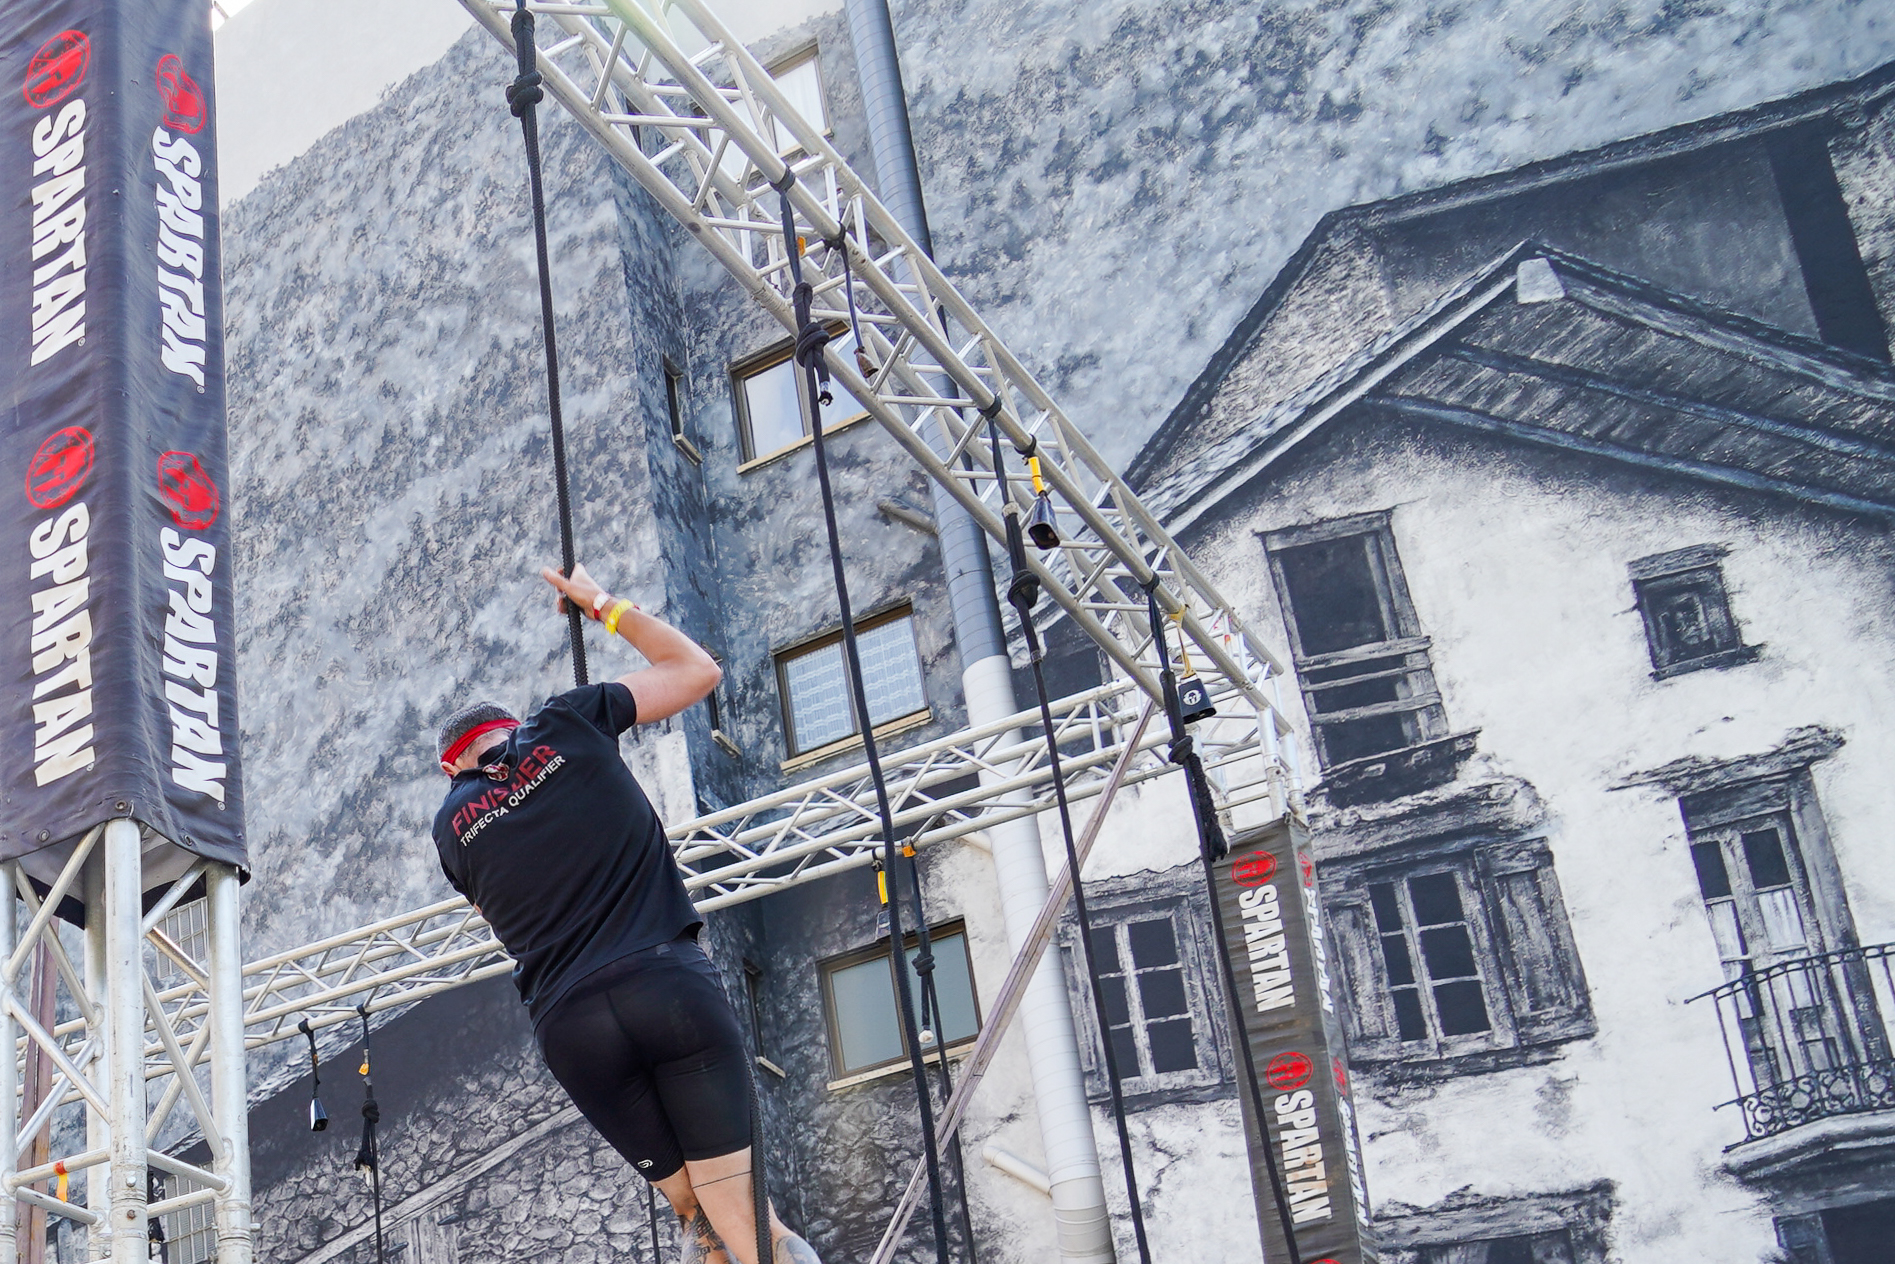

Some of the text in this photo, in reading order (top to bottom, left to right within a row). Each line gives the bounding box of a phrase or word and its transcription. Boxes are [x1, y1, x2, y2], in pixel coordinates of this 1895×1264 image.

[30, 99, 87, 367] SPARTAN
[151, 125, 207, 388] SPARTAN
[29, 501, 96, 788] SPARTAN
[159, 527, 227, 802] SPARTAN
[460, 754, 566, 847] TRIFECTA QUALIFIER
[1238, 884, 1296, 1013] SPARTAN
[1274, 1089, 1333, 1225] SPARTAN
